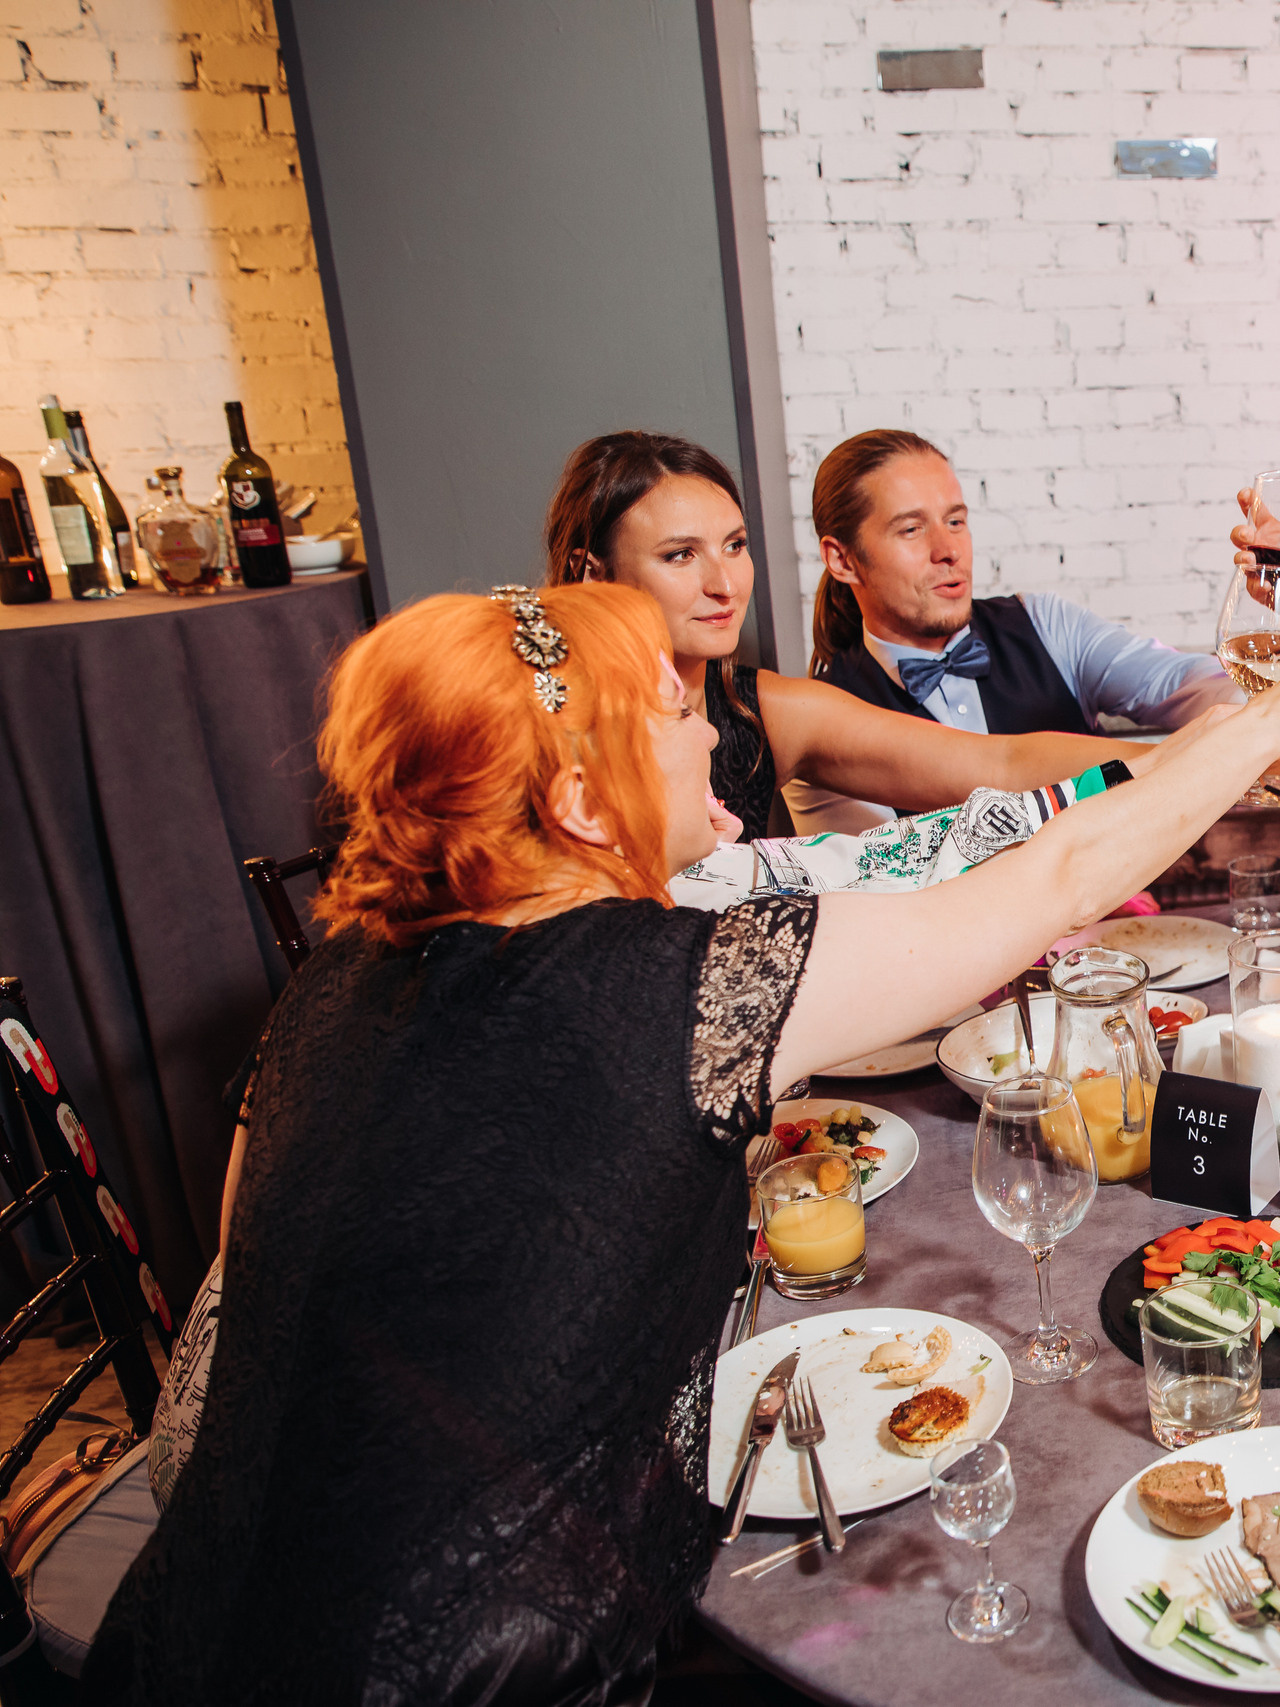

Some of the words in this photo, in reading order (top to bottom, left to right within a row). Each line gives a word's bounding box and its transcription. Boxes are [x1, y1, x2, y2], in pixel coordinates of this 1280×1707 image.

[1178, 1106, 1227, 1129] TABLE
[1188, 1126, 1213, 1145] No.
[1193, 1155, 1206, 1175] 3
